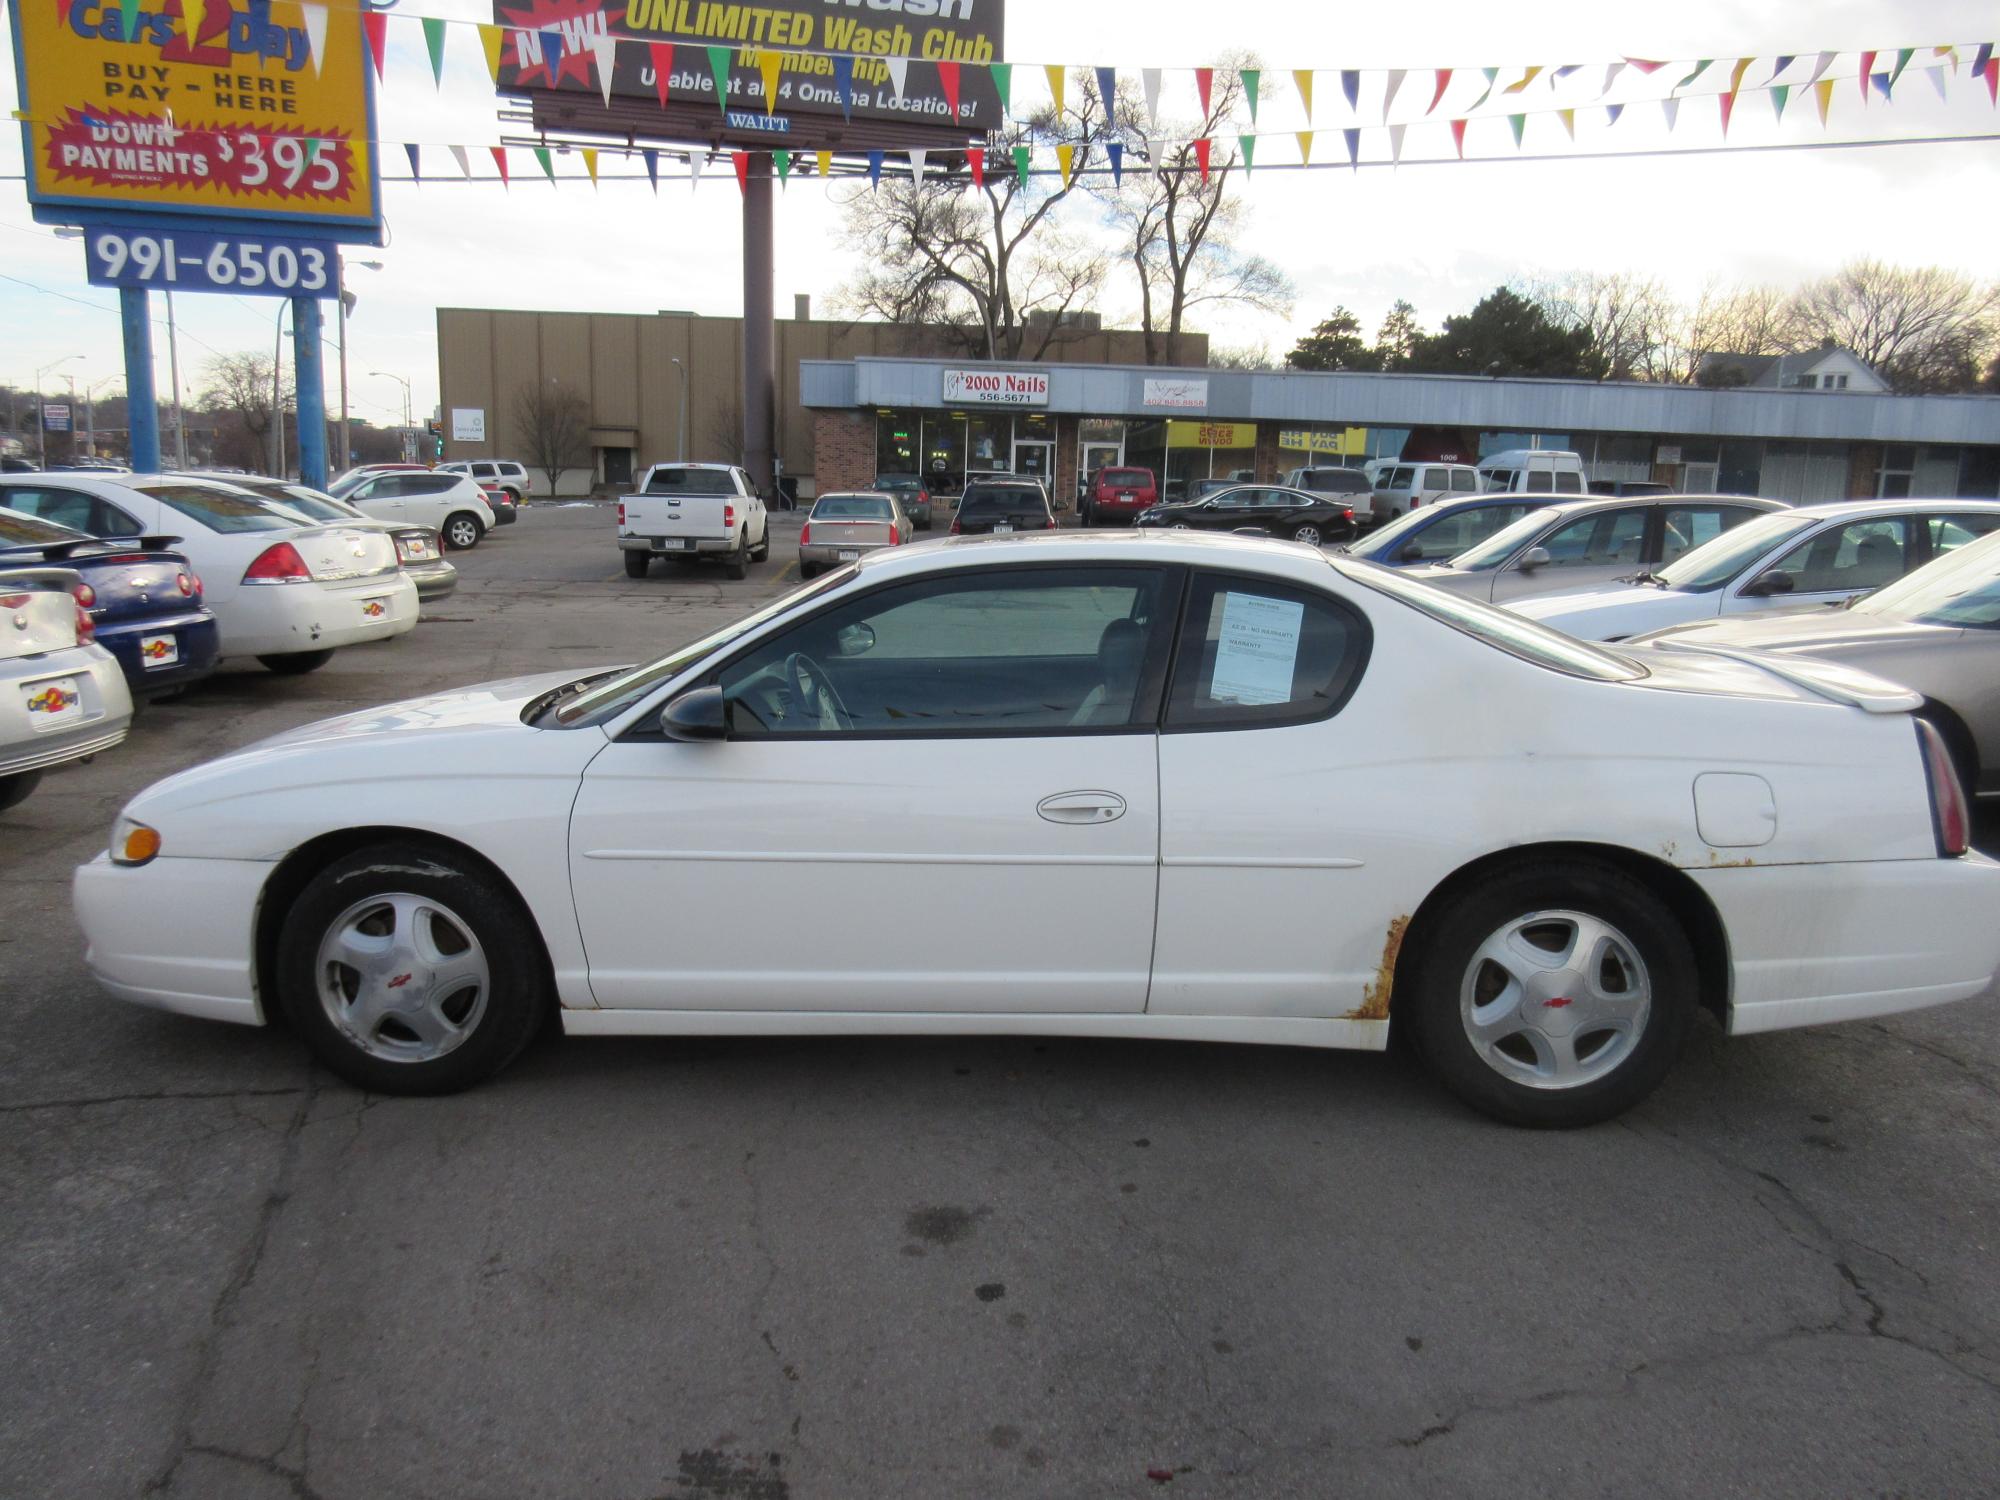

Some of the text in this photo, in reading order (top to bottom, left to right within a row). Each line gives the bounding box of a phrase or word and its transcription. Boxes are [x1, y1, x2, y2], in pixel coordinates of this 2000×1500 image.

[625, 0, 993, 67] UNLIMITED Wash Club
[103, 62, 170, 83] BUY
[214, 73, 296, 95] HERE
[641, 67, 714, 92] Uable
[779, 81, 792, 100] 4
[105, 82, 298, 114] PAY HERE
[92, 120, 175, 147] DOWN
[728, 113, 788, 132] WAITT
[62, 143, 209, 177] PAYMENTS
[97, 234, 327, 290] 991-6503
[965, 375, 1046, 393] 2000 Nails
[979, 393, 1031, 402] 556-5671
